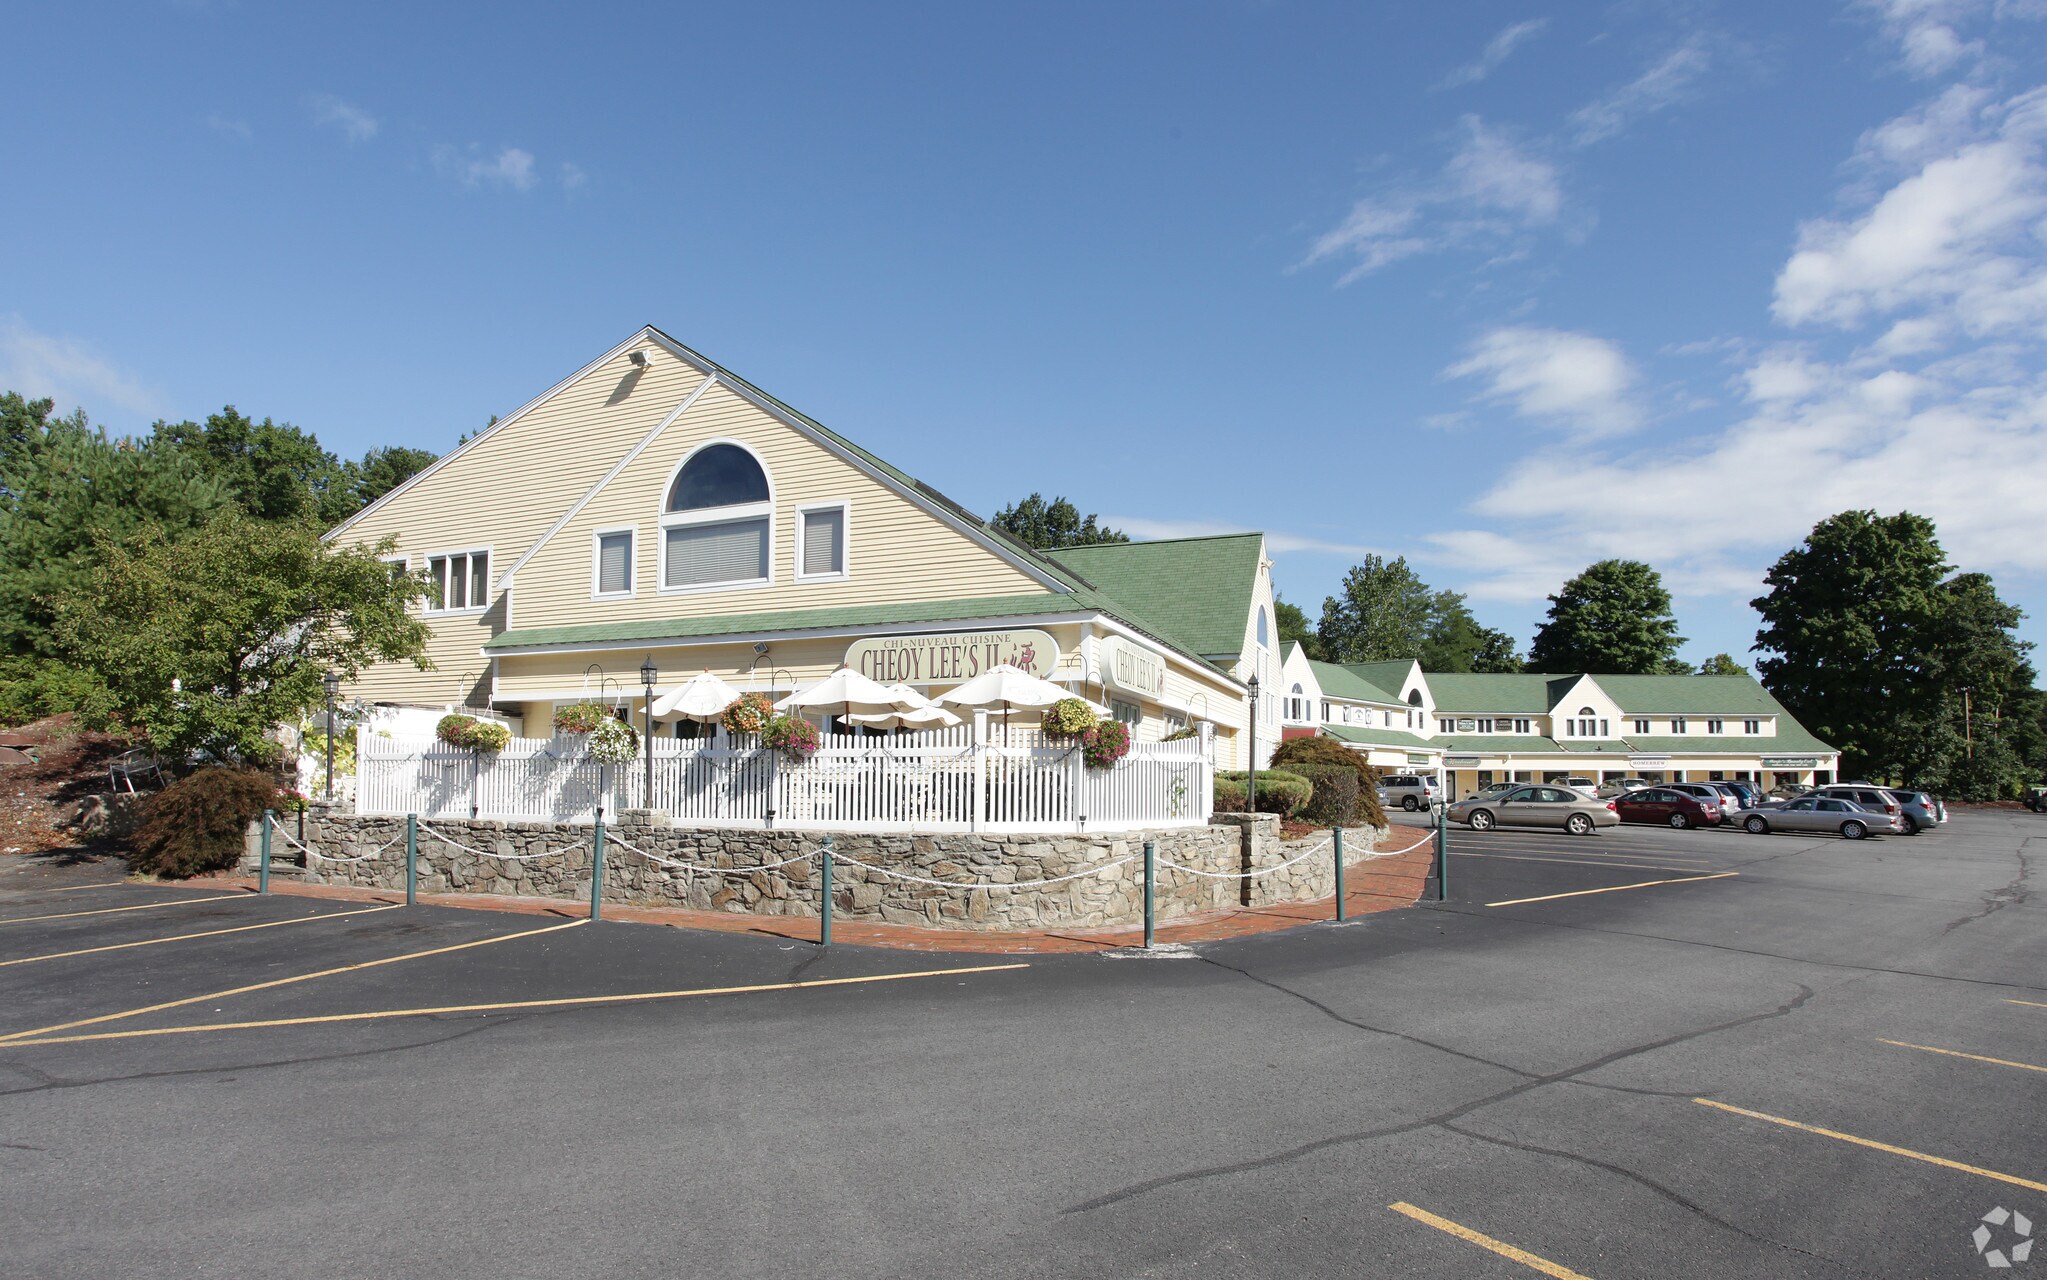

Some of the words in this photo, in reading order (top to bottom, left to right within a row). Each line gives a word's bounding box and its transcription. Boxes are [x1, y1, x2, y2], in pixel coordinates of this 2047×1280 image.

[884, 637, 957, 648] CHI-NUVEAU
[963, 634, 1011, 644] CUISINE
[861, 648, 923, 681] CHEOY
[929, 644, 978, 679] LEE'S
[1117, 648, 1135, 686] CHEOY
[1137, 657, 1151, 691] LEE'S
